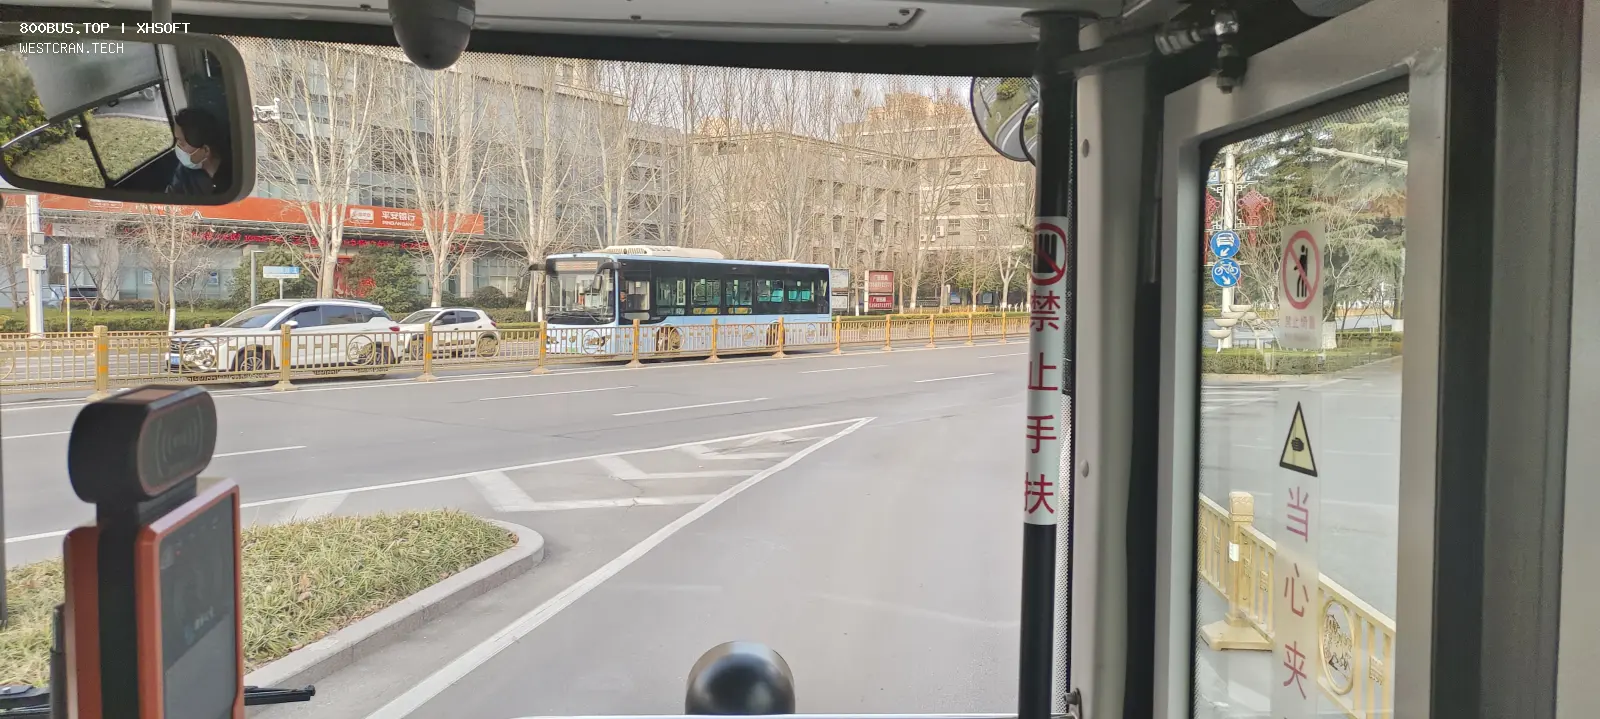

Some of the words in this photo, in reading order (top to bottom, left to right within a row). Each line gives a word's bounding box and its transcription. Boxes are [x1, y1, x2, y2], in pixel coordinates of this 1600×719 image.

[381, 210, 416, 221] 平安银行
[1024, 289, 1061, 515] 禁止手扶
[1283, 486, 1310, 719] 当心夹
